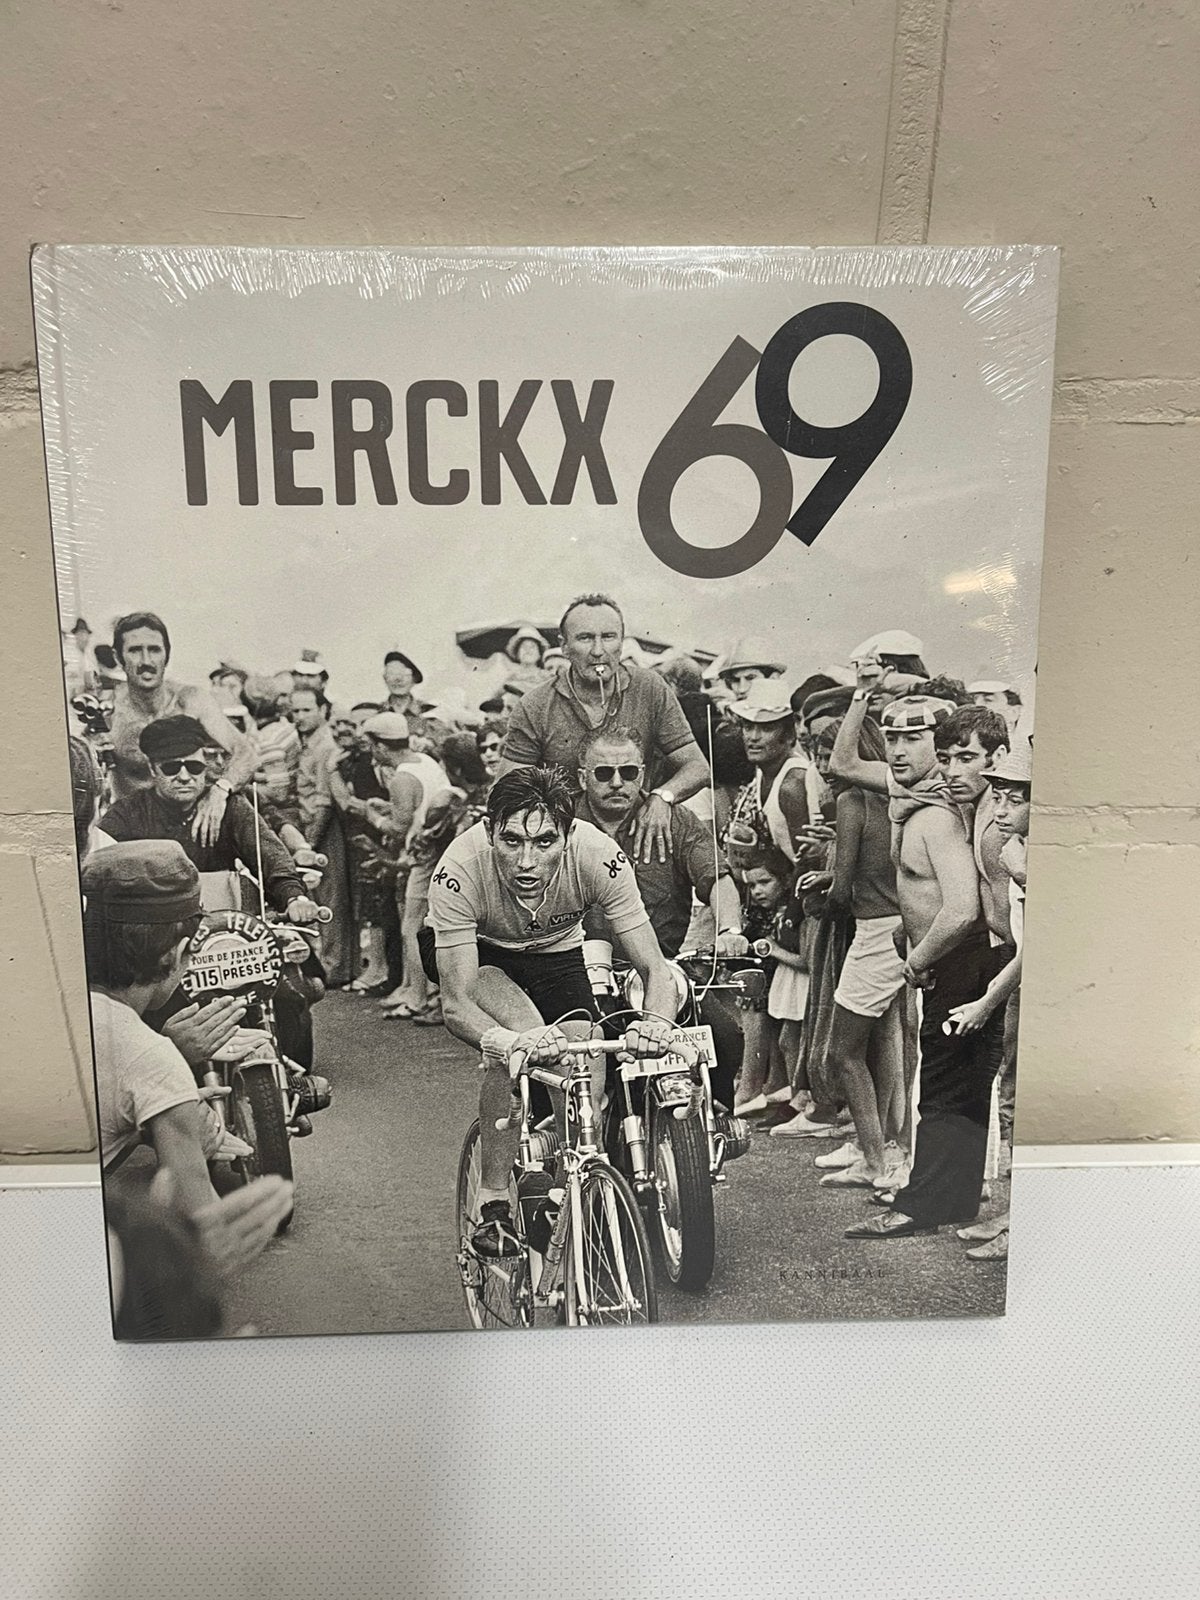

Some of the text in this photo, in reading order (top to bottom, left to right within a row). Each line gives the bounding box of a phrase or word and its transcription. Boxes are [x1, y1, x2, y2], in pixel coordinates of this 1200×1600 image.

[180, 301, 913, 579] MERCKX 69
[191, 946, 264, 966] TOUR DE FRANCE
[195, 969, 219, 988] 115
[223, 962, 269, 981] PRESSE
[779, 1269, 886, 1280] KANNIBAAL
